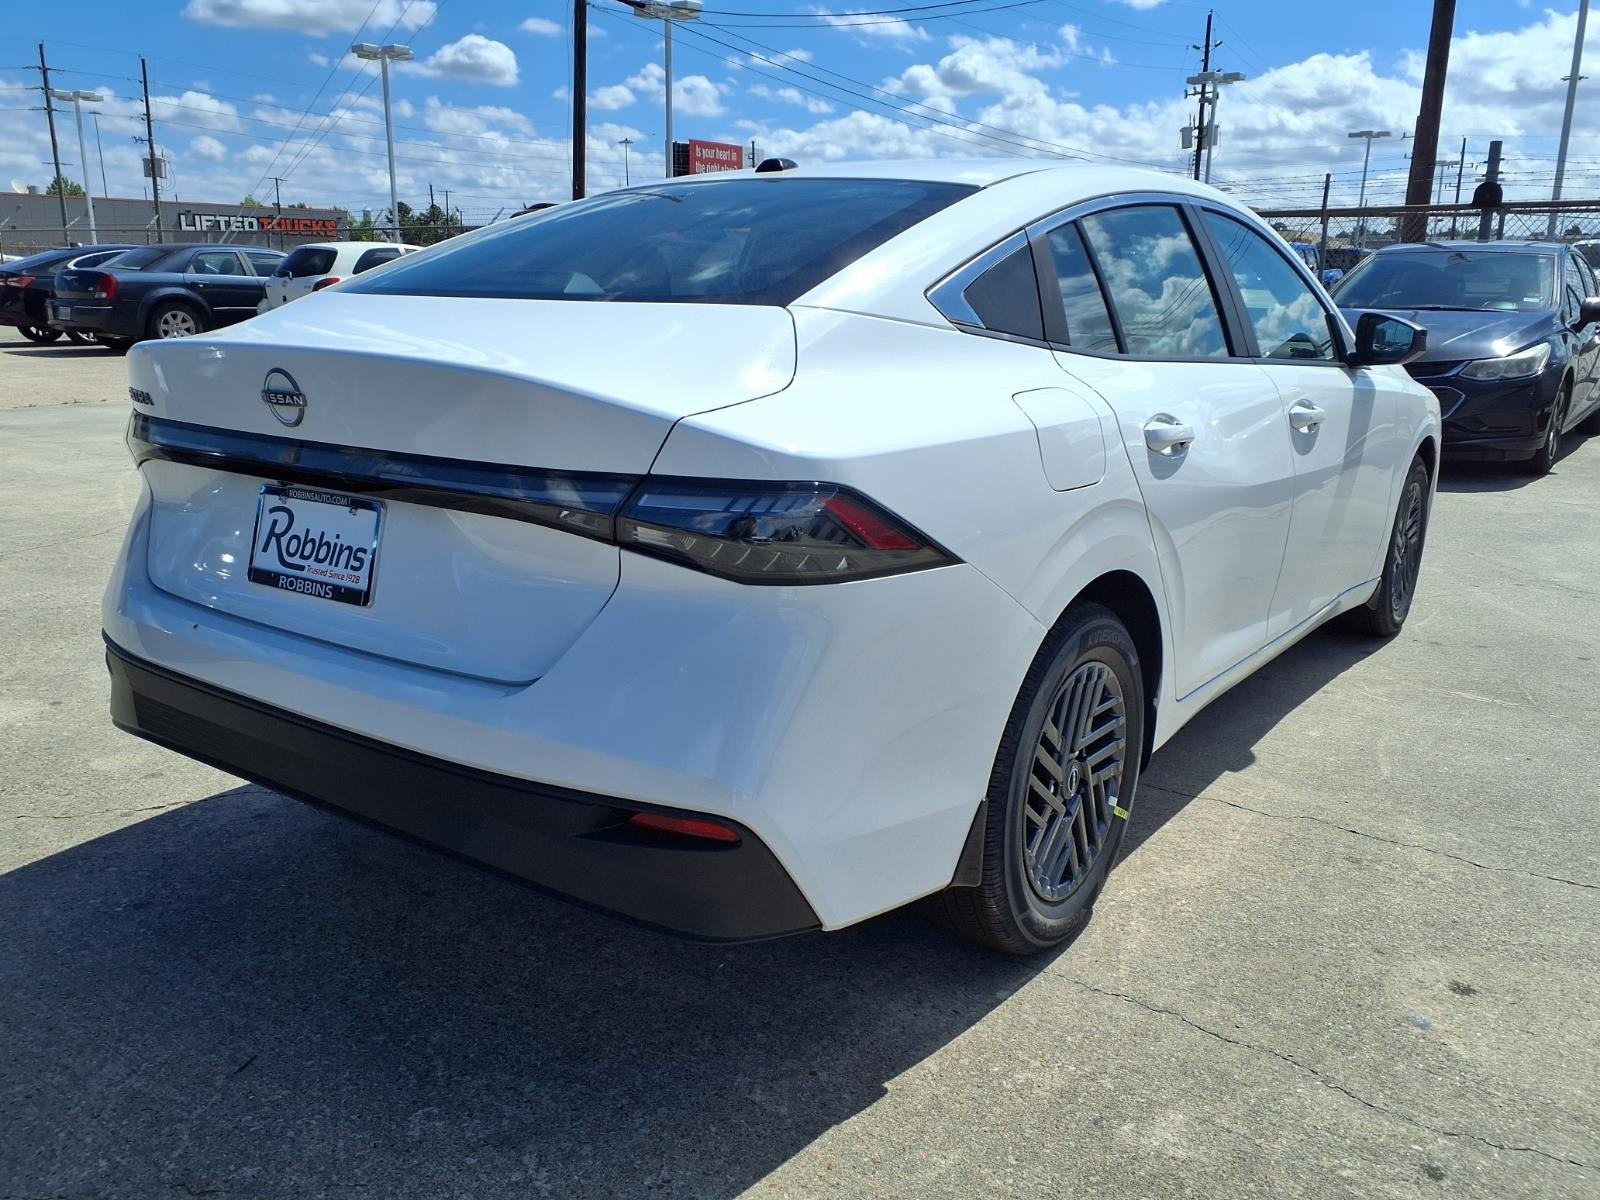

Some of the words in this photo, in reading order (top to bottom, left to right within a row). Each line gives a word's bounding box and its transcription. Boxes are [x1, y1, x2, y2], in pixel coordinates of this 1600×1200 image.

[696, 145, 702, 158] Is
[702, 147, 715, 160] your
[715, 147, 731, 161] heart
[731, 151, 737, 161] in
[180, 214, 258, 231] LIFTED
[258, 216, 338, 237] TRUCKS
[262, 391, 303, 405] NISSAN
[289, 489, 348, 506] ROBBINSAUTO.COM
[262, 506, 367, 572] Robbins
[306, 565, 328, 577] Trusted
[328, 570, 345, 581] Since
[345, 573, 360, 584] 1928
[278, 575, 333, 598] ROBBINS
